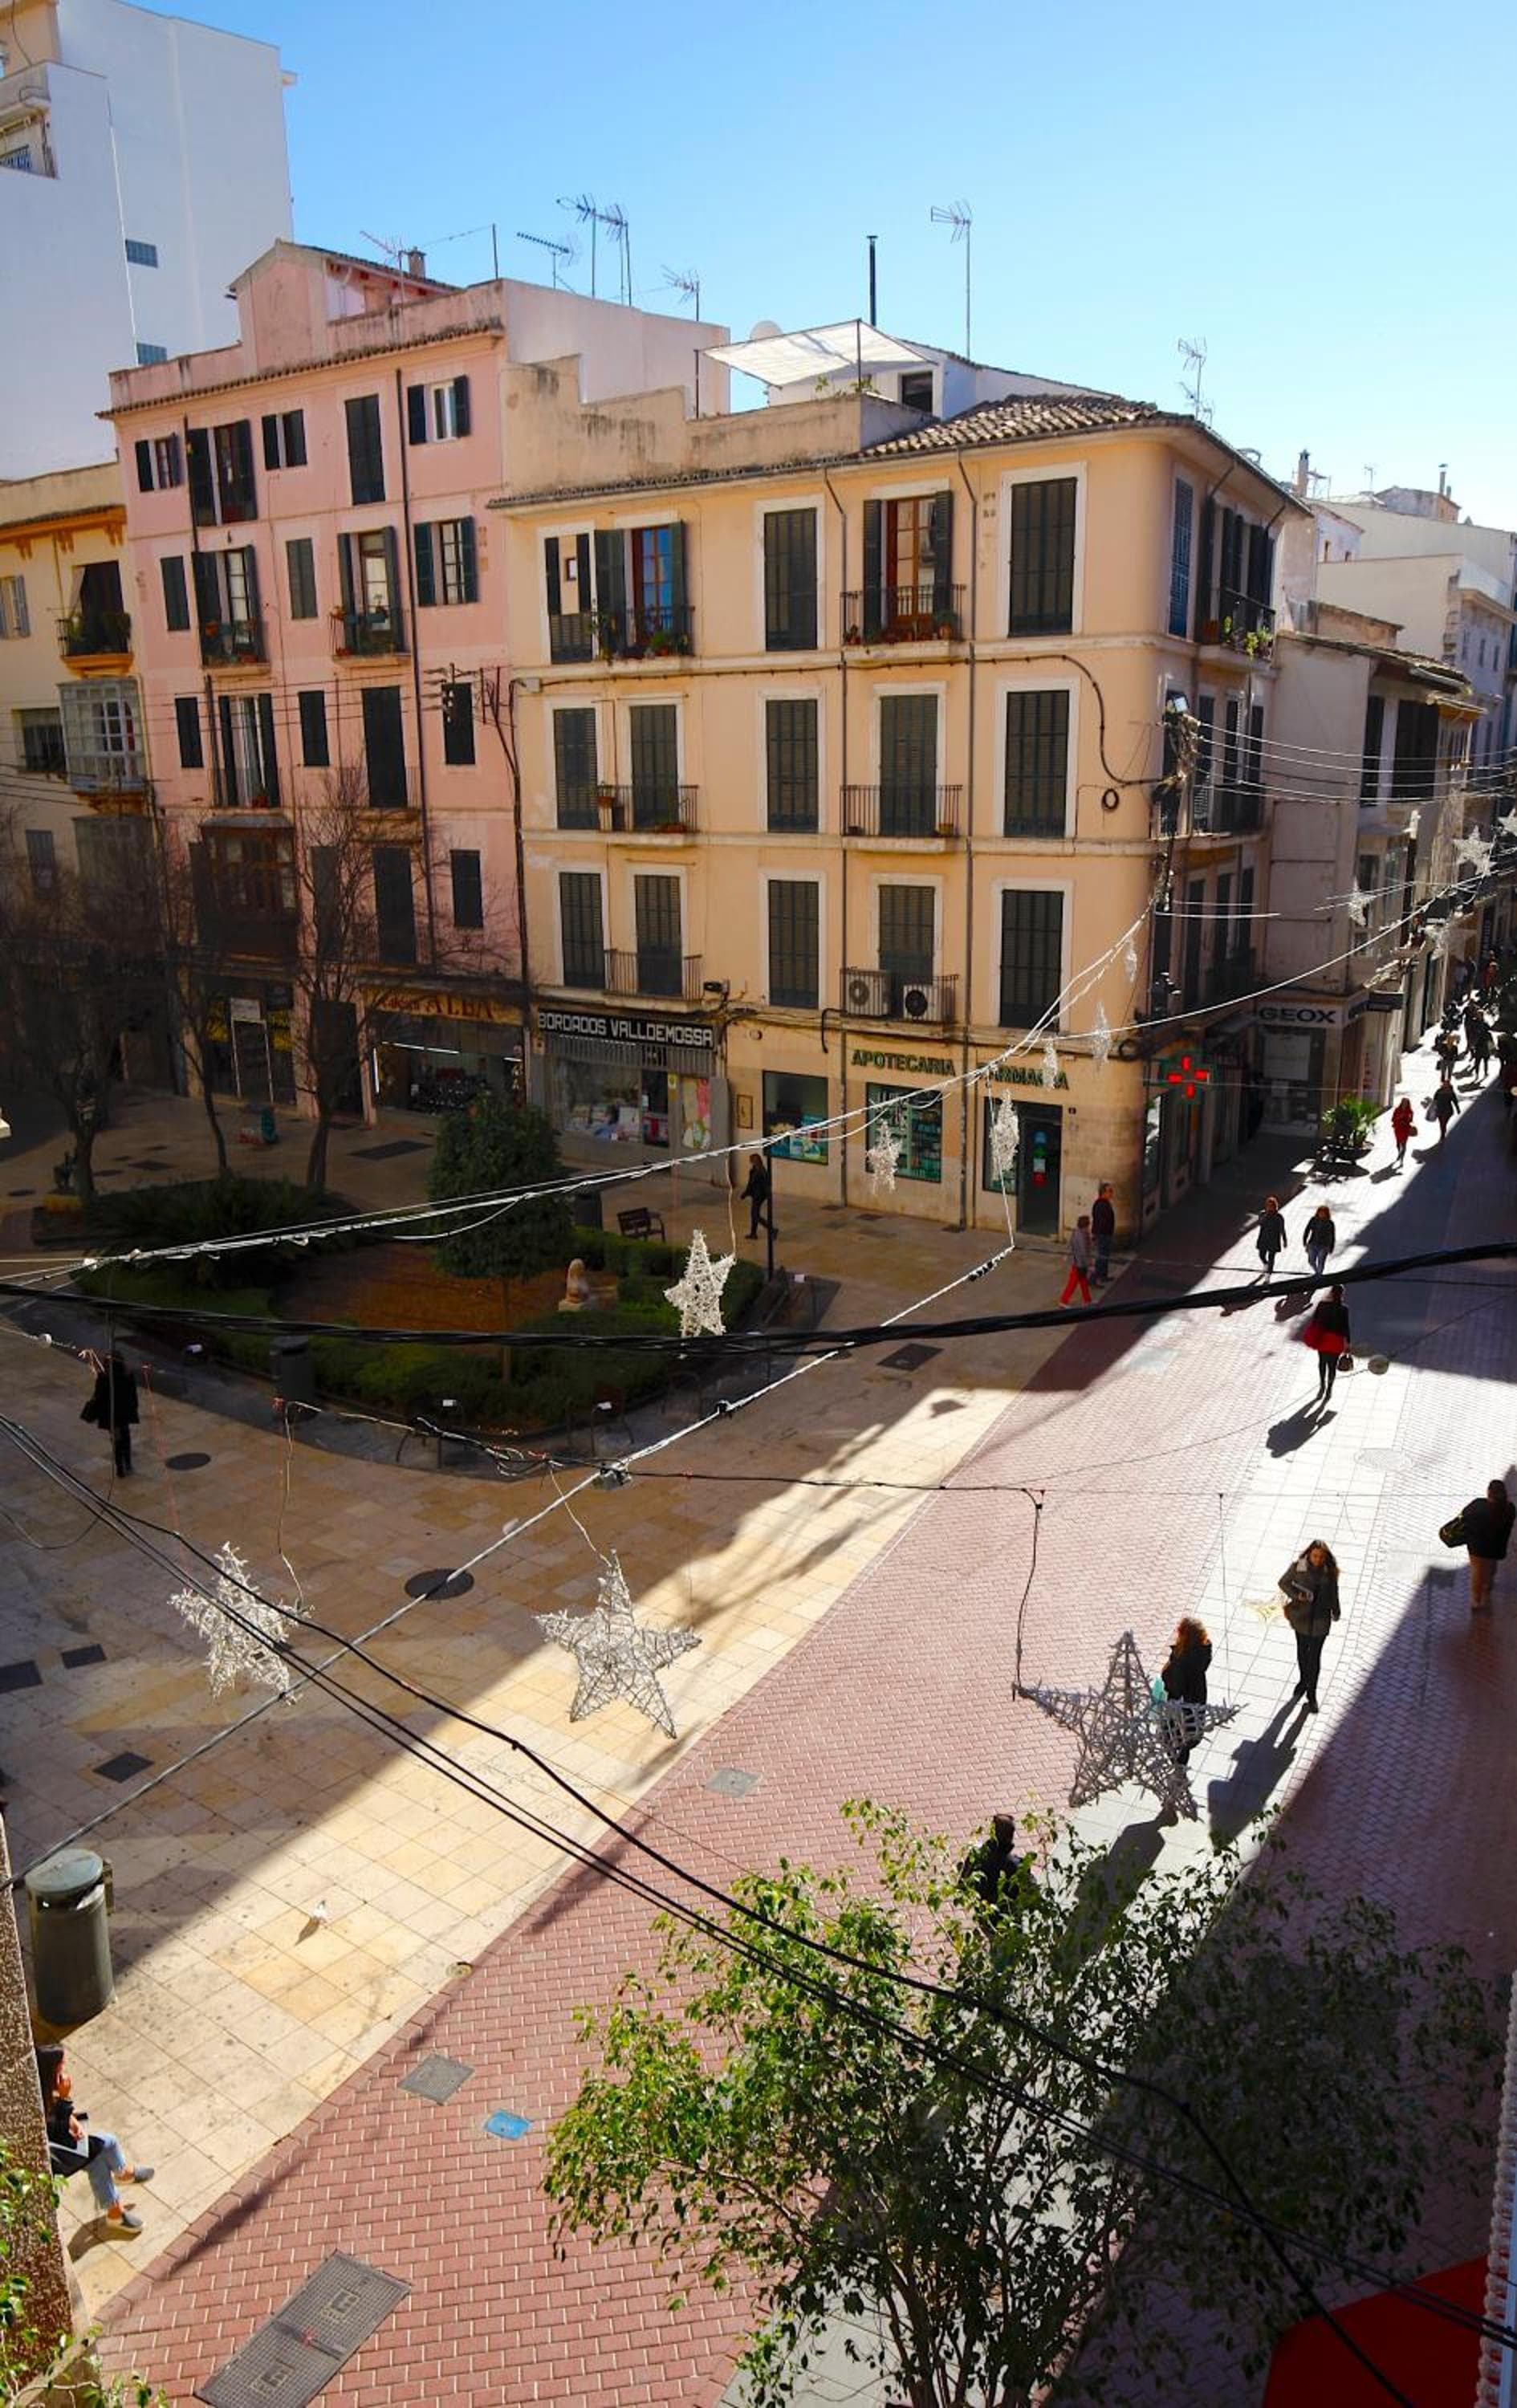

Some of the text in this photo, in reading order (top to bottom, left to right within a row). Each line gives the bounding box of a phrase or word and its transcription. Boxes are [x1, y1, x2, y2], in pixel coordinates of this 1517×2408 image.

[539, 1011, 714, 1047] BORDADOS VALLDEMOSSA
[1259, 1007, 1336, 1023] GEOX
[851, 1048, 956, 1076] APOTECARIA
